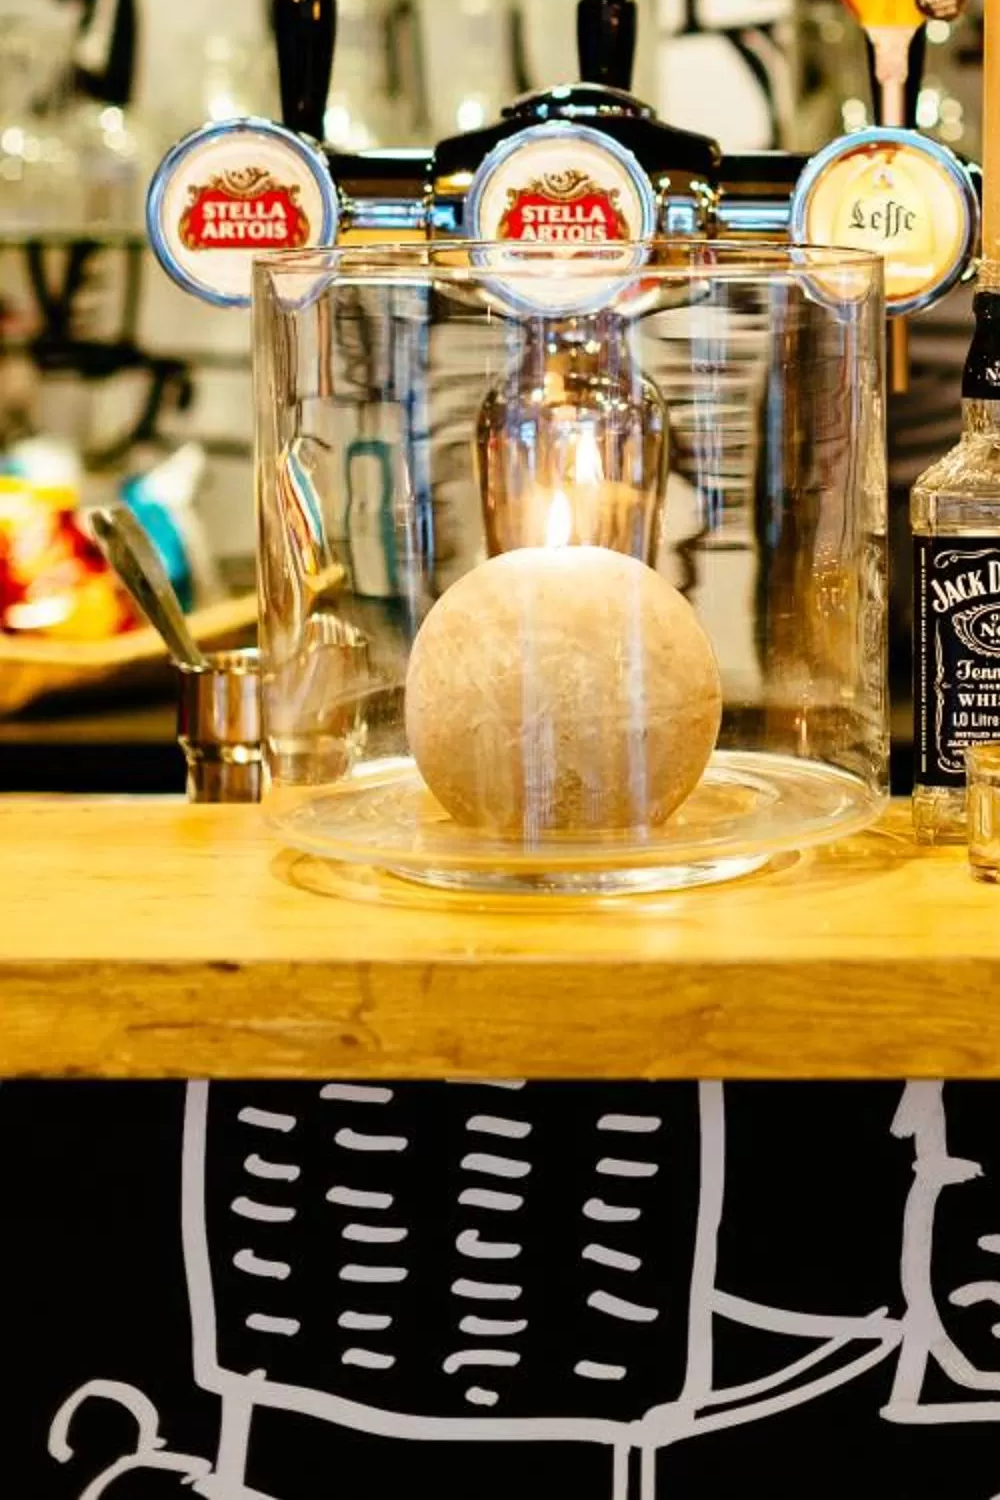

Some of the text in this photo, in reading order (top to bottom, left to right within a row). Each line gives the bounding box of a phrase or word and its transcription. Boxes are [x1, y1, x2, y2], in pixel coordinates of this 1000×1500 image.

[202, 202, 286, 220] STELLA
[521, 205, 607, 222] STELLA
[848, 199, 916, 238] Leffe
[201, 222, 288, 240] ARTOIS
[521, 224, 608, 242] ARTOIS
[931, 569, 988, 613] JACK
[971, 712, 999, 727] Litre
